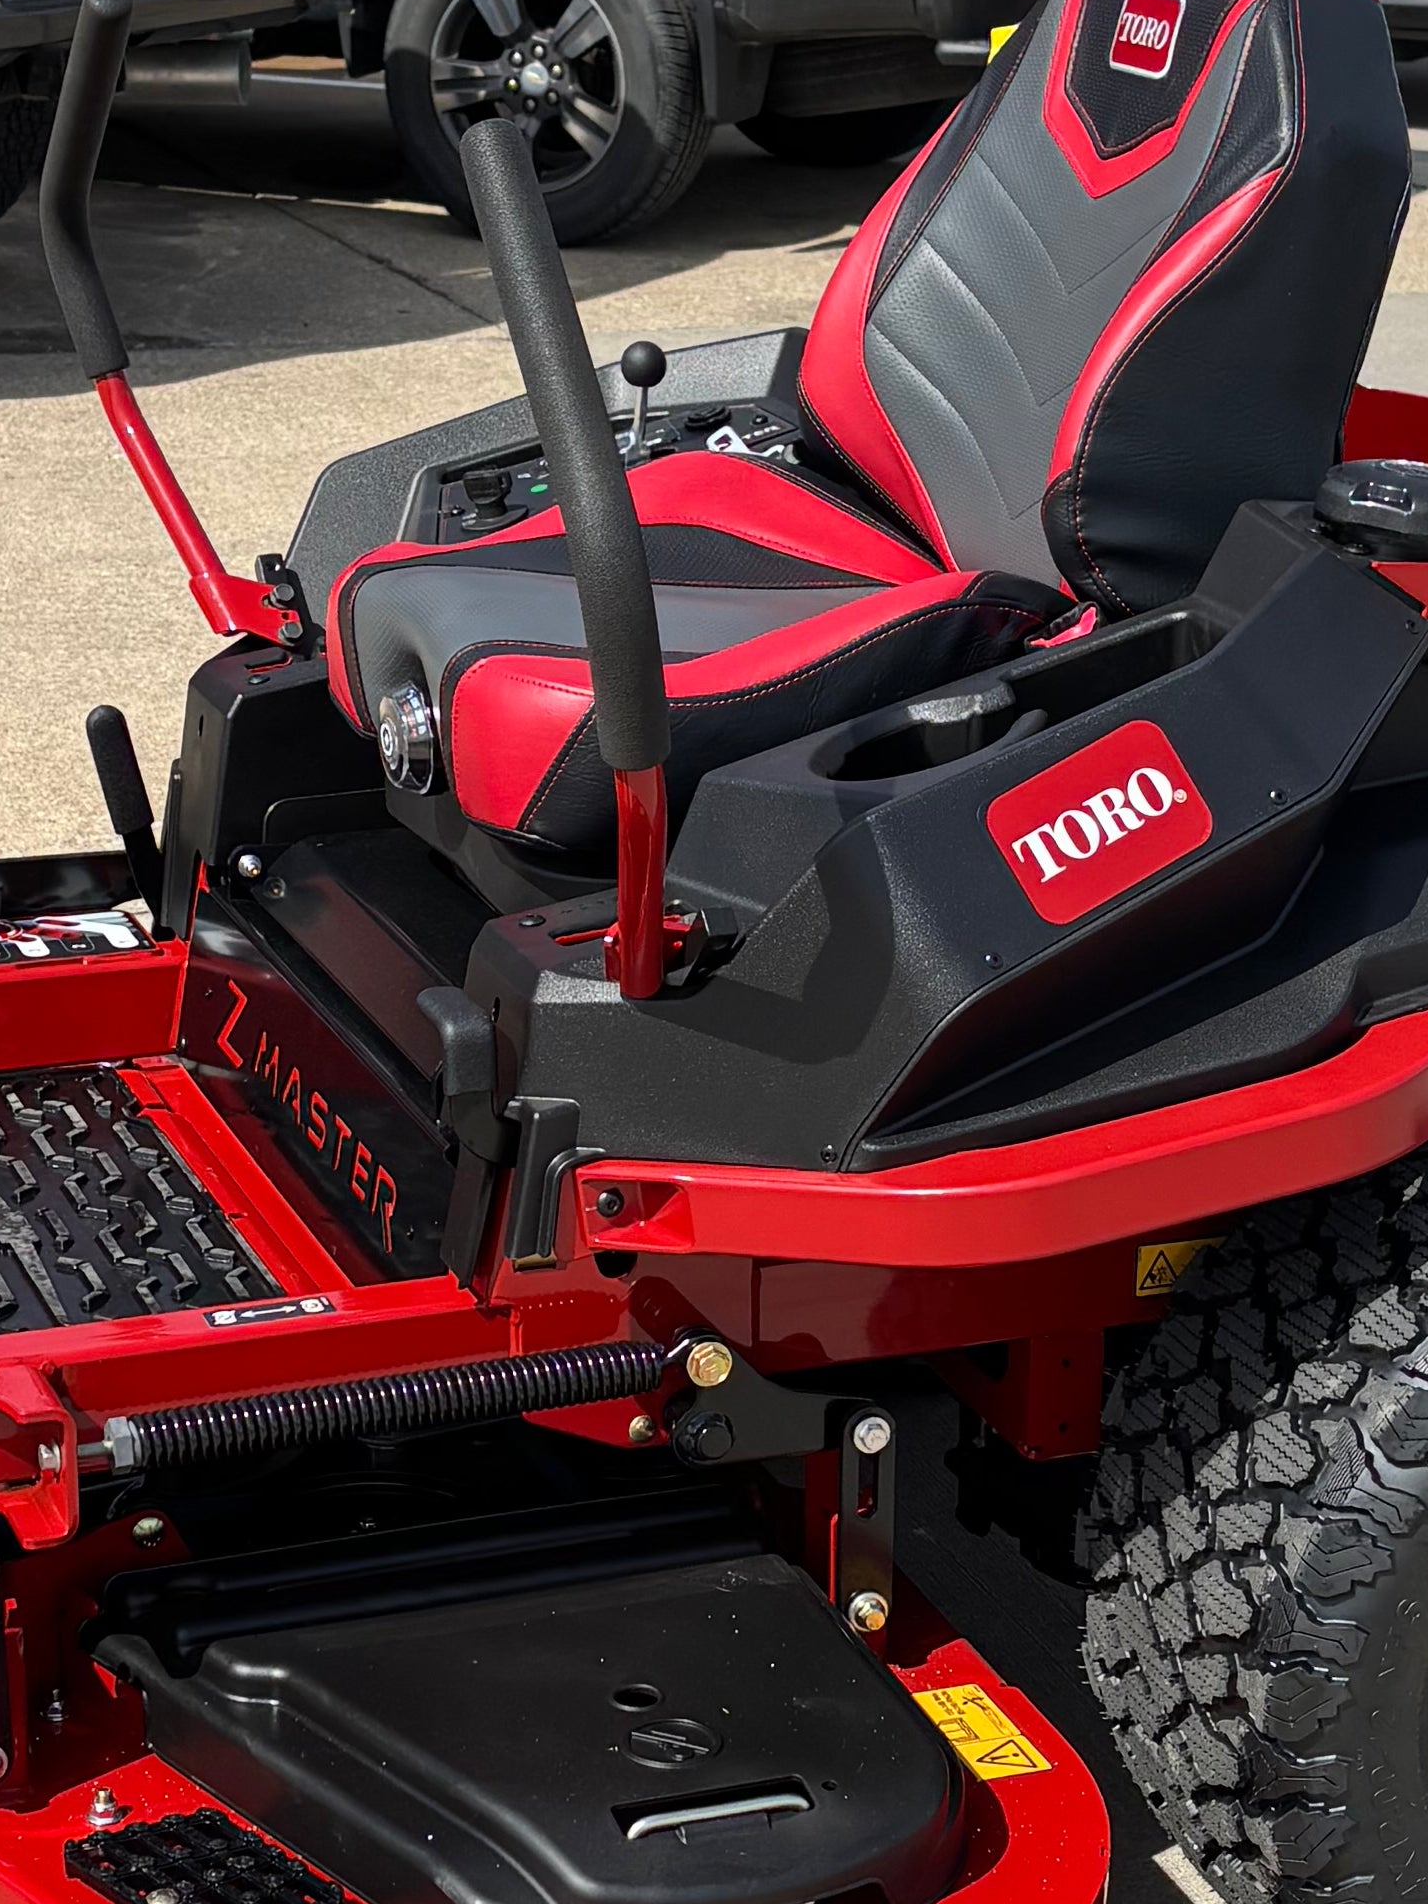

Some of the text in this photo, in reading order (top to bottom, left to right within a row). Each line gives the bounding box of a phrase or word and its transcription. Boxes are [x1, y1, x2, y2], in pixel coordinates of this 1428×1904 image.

[1118, 9, 1172, 51] TORO
[1012, 765, 1175, 884] TORO
[253, 1029, 399, 1255] MASTER
